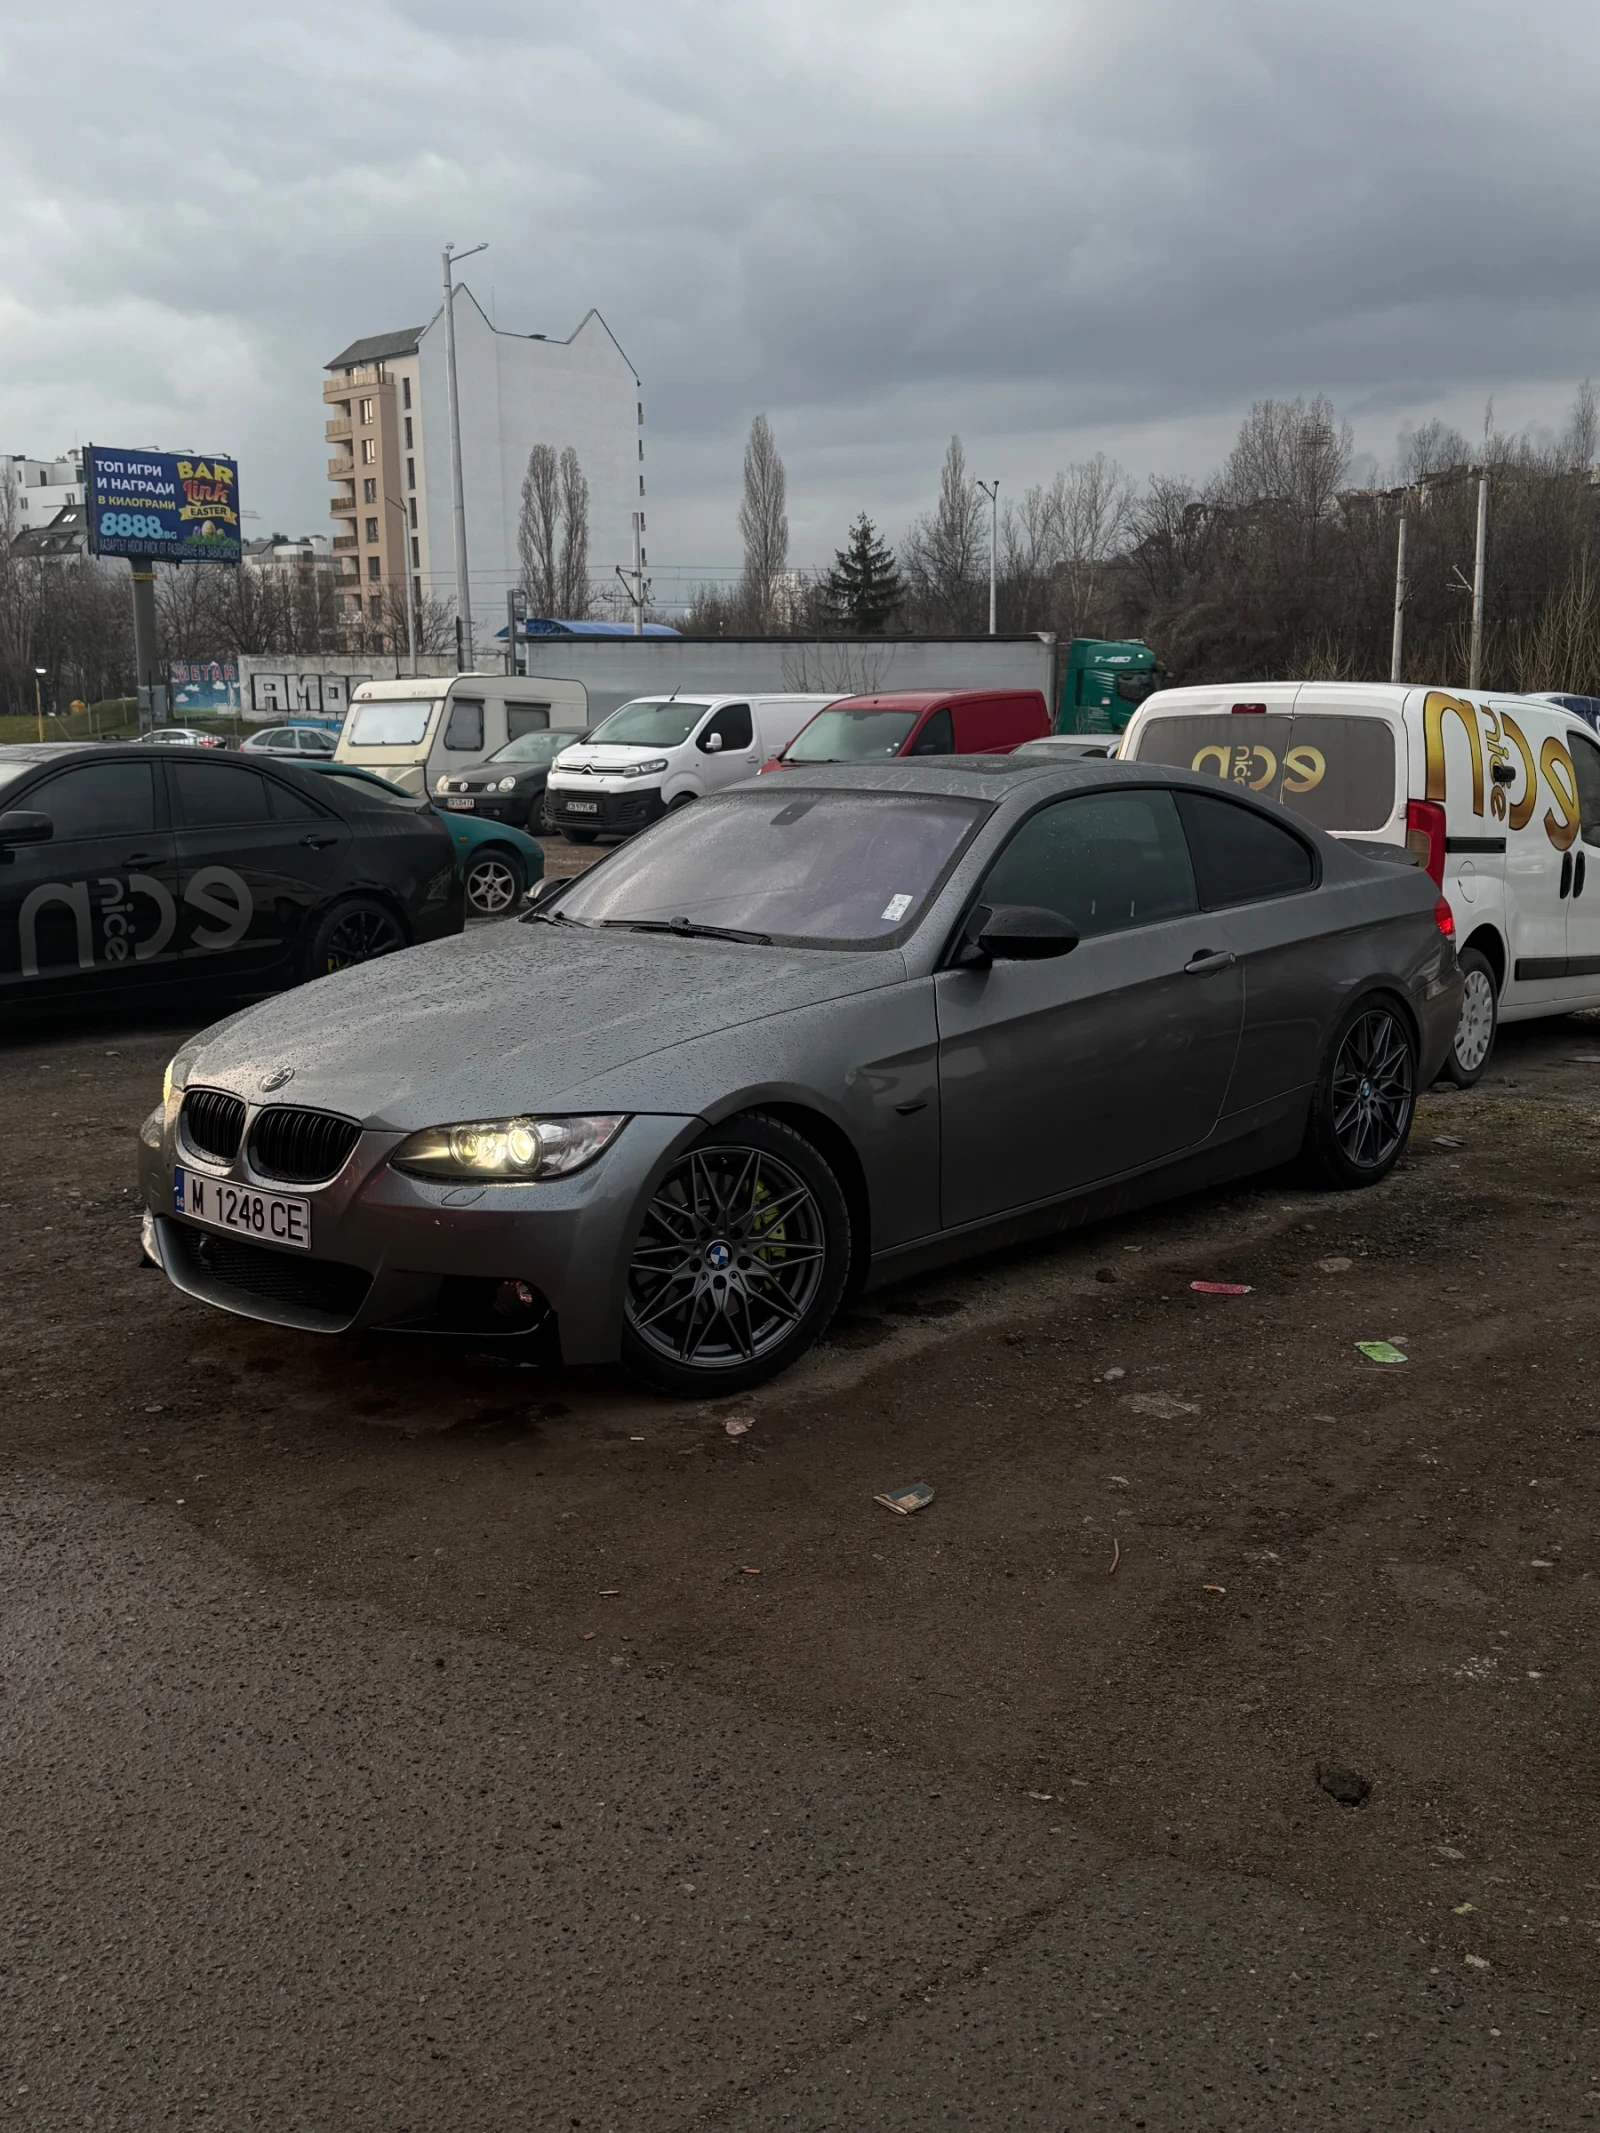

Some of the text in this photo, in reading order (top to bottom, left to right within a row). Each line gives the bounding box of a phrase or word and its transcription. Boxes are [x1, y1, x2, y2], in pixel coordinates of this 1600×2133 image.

[95, 460, 162, 477] ТОП ИГРИ
[176, 461, 234, 486] BAR
[97, 477, 175, 495] И НАГРАДИ
[183, 479, 229, 506] Link
[97, 495, 176, 510] В КИЛОГРАМИ
[190, 506, 227, 516] EASTER
[175, 664, 235, 681] МЕТАН
[192, 1178, 204, 1215] M
[216, 1187, 265, 1232] 1248
[270, 1201, 303, 1241] CE
